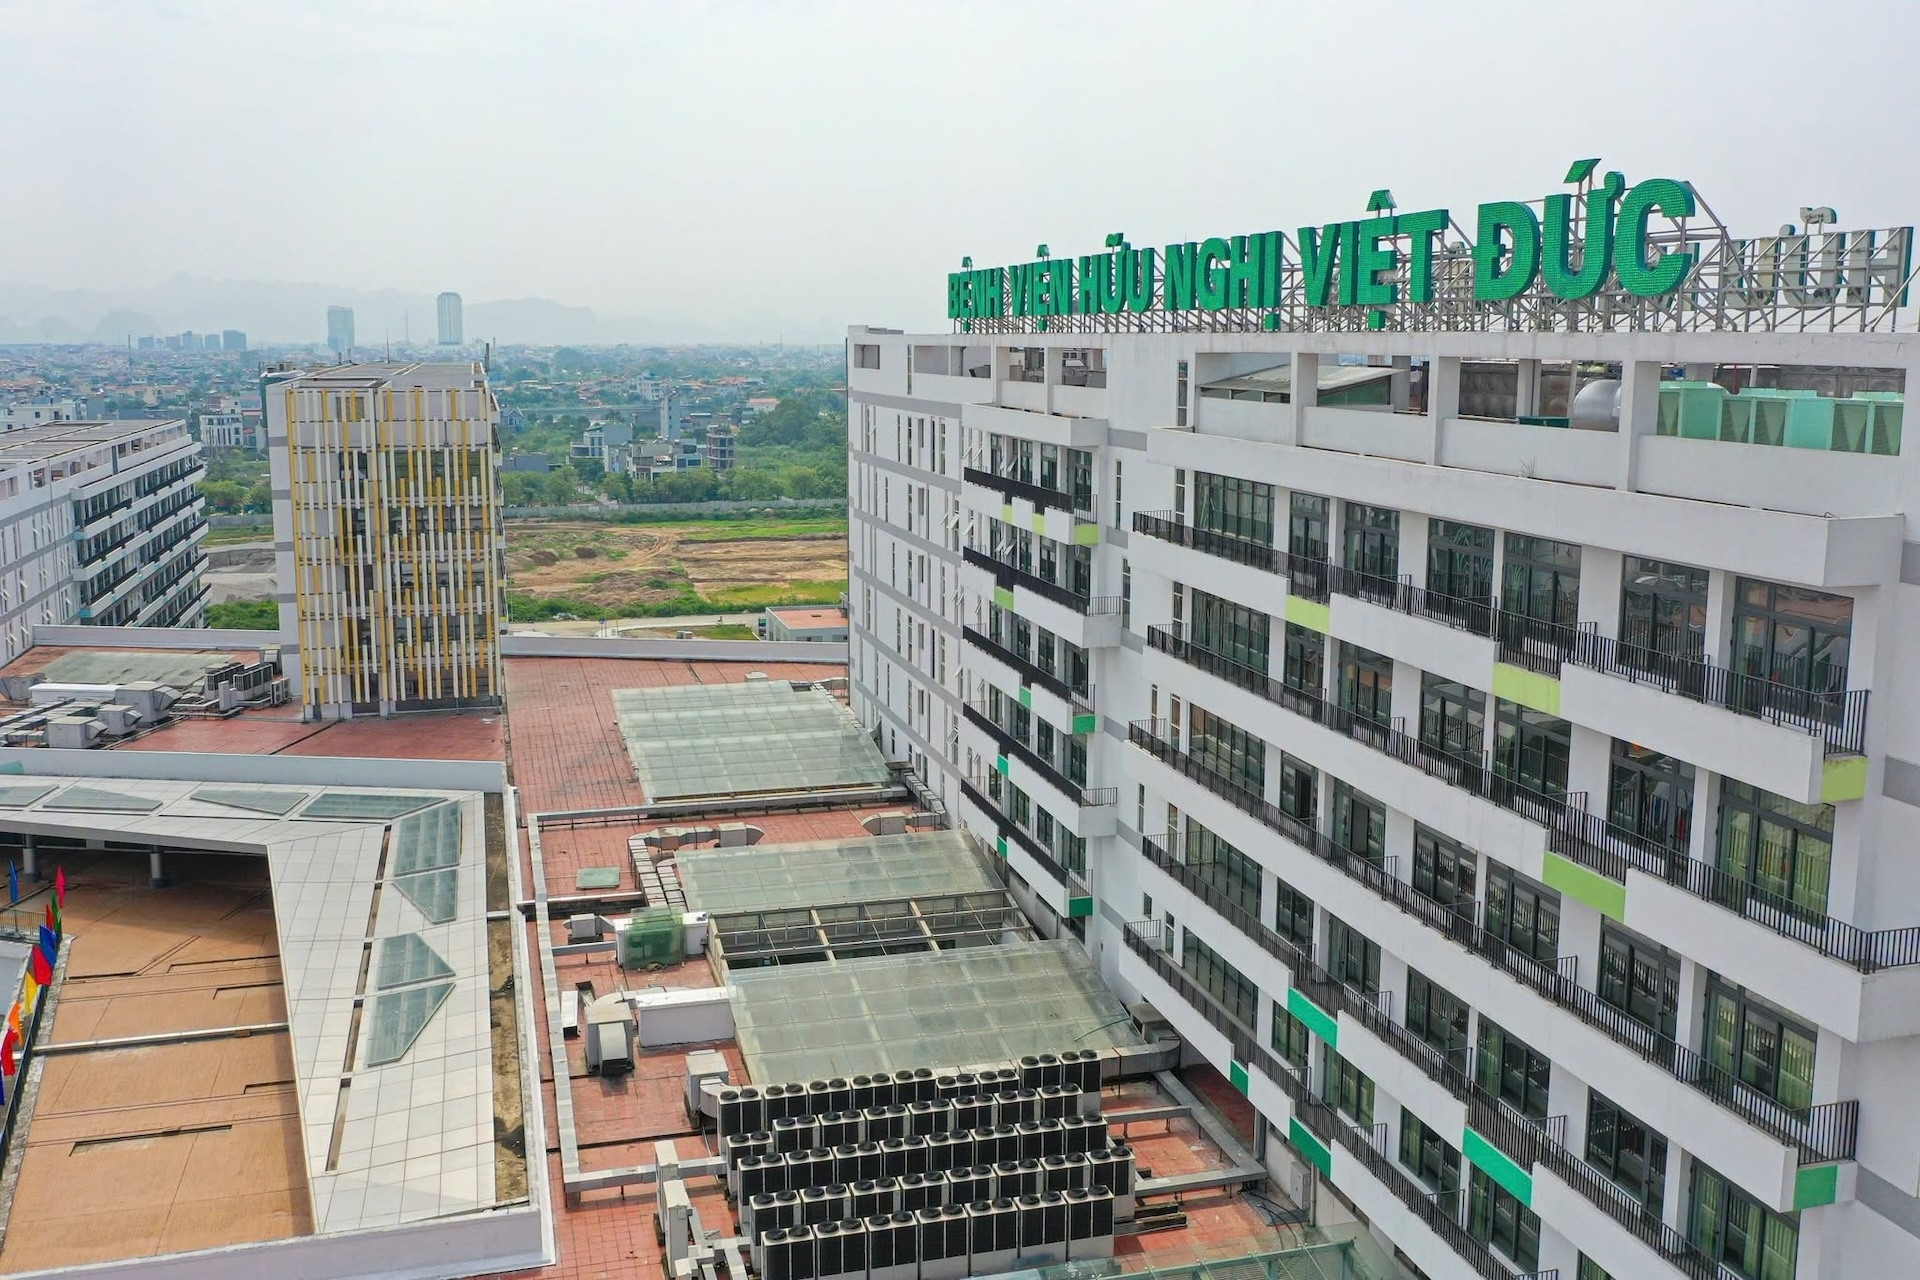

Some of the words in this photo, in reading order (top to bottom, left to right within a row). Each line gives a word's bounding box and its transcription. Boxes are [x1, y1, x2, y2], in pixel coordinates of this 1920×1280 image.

[948, 256, 1004, 331] BỆNH
[1008, 244, 1072, 331] VIỆN
[1078, 233, 1154, 314] HỮU
[1165, 231, 1284, 330] NGHỊ
[1297, 190, 1449, 329] VIỆT
[1473, 158, 1696, 299] ĐỨC
